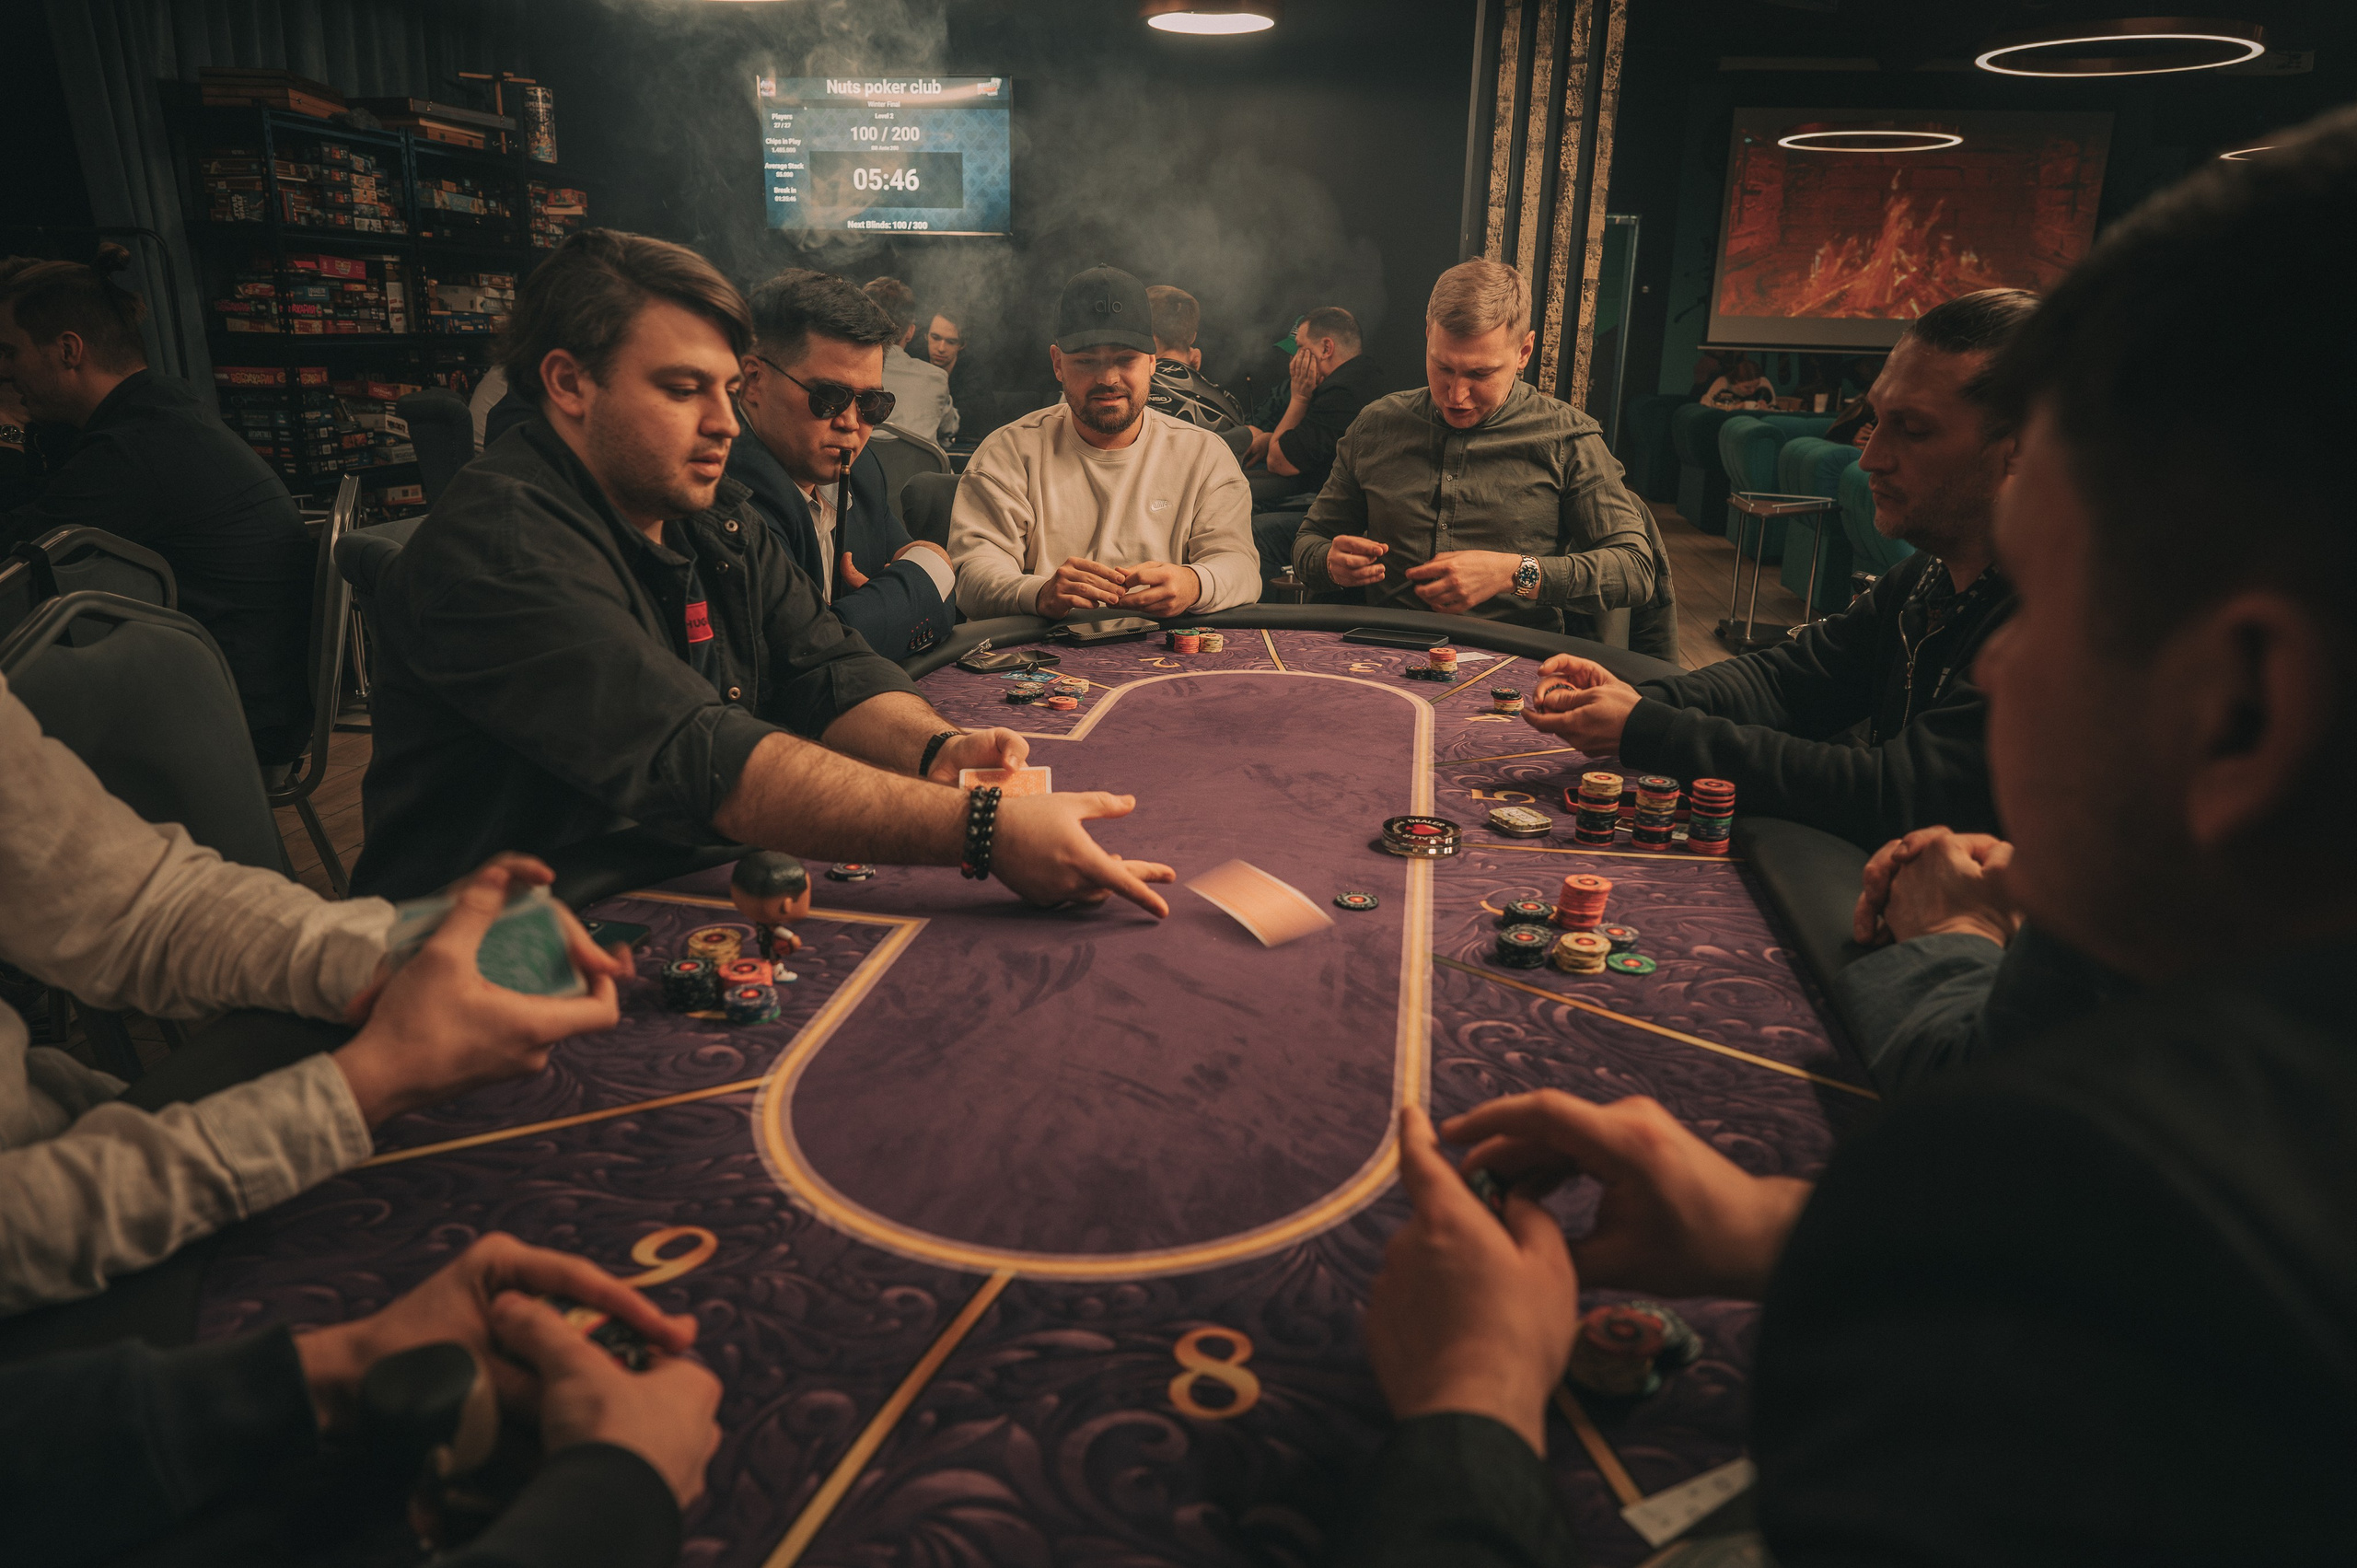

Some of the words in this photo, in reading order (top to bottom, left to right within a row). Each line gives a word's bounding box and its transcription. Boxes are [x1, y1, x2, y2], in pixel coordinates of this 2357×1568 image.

[827, 79, 862, 94] Nuts
[865, 79, 907, 98] poker
[910, 79, 942, 94] club
[772, 113, 793, 122] Players
[765, 137, 782, 145] Chips
[788, 137, 802, 146] Play
[850, 126, 878, 141] 100
[880, 126, 888, 142] /
[891, 126, 920, 141] 200
[764, 162, 788, 170] Average
[853, 168, 920, 191] 05:46
[847, 220, 865, 229] Next
[865, 220, 891, 229] Blinds:
[892, 221, 907, 229] 100
[913, 221, 928, 230] 300
[1095, 294, 1123, 314] alo
[1470, 787, 1537, 804] 5
[1407, 819, 1446, 827] DEALER
[624, 1225, 720, 1289] 9
[1167, 1326, 1262, 1421] 8
